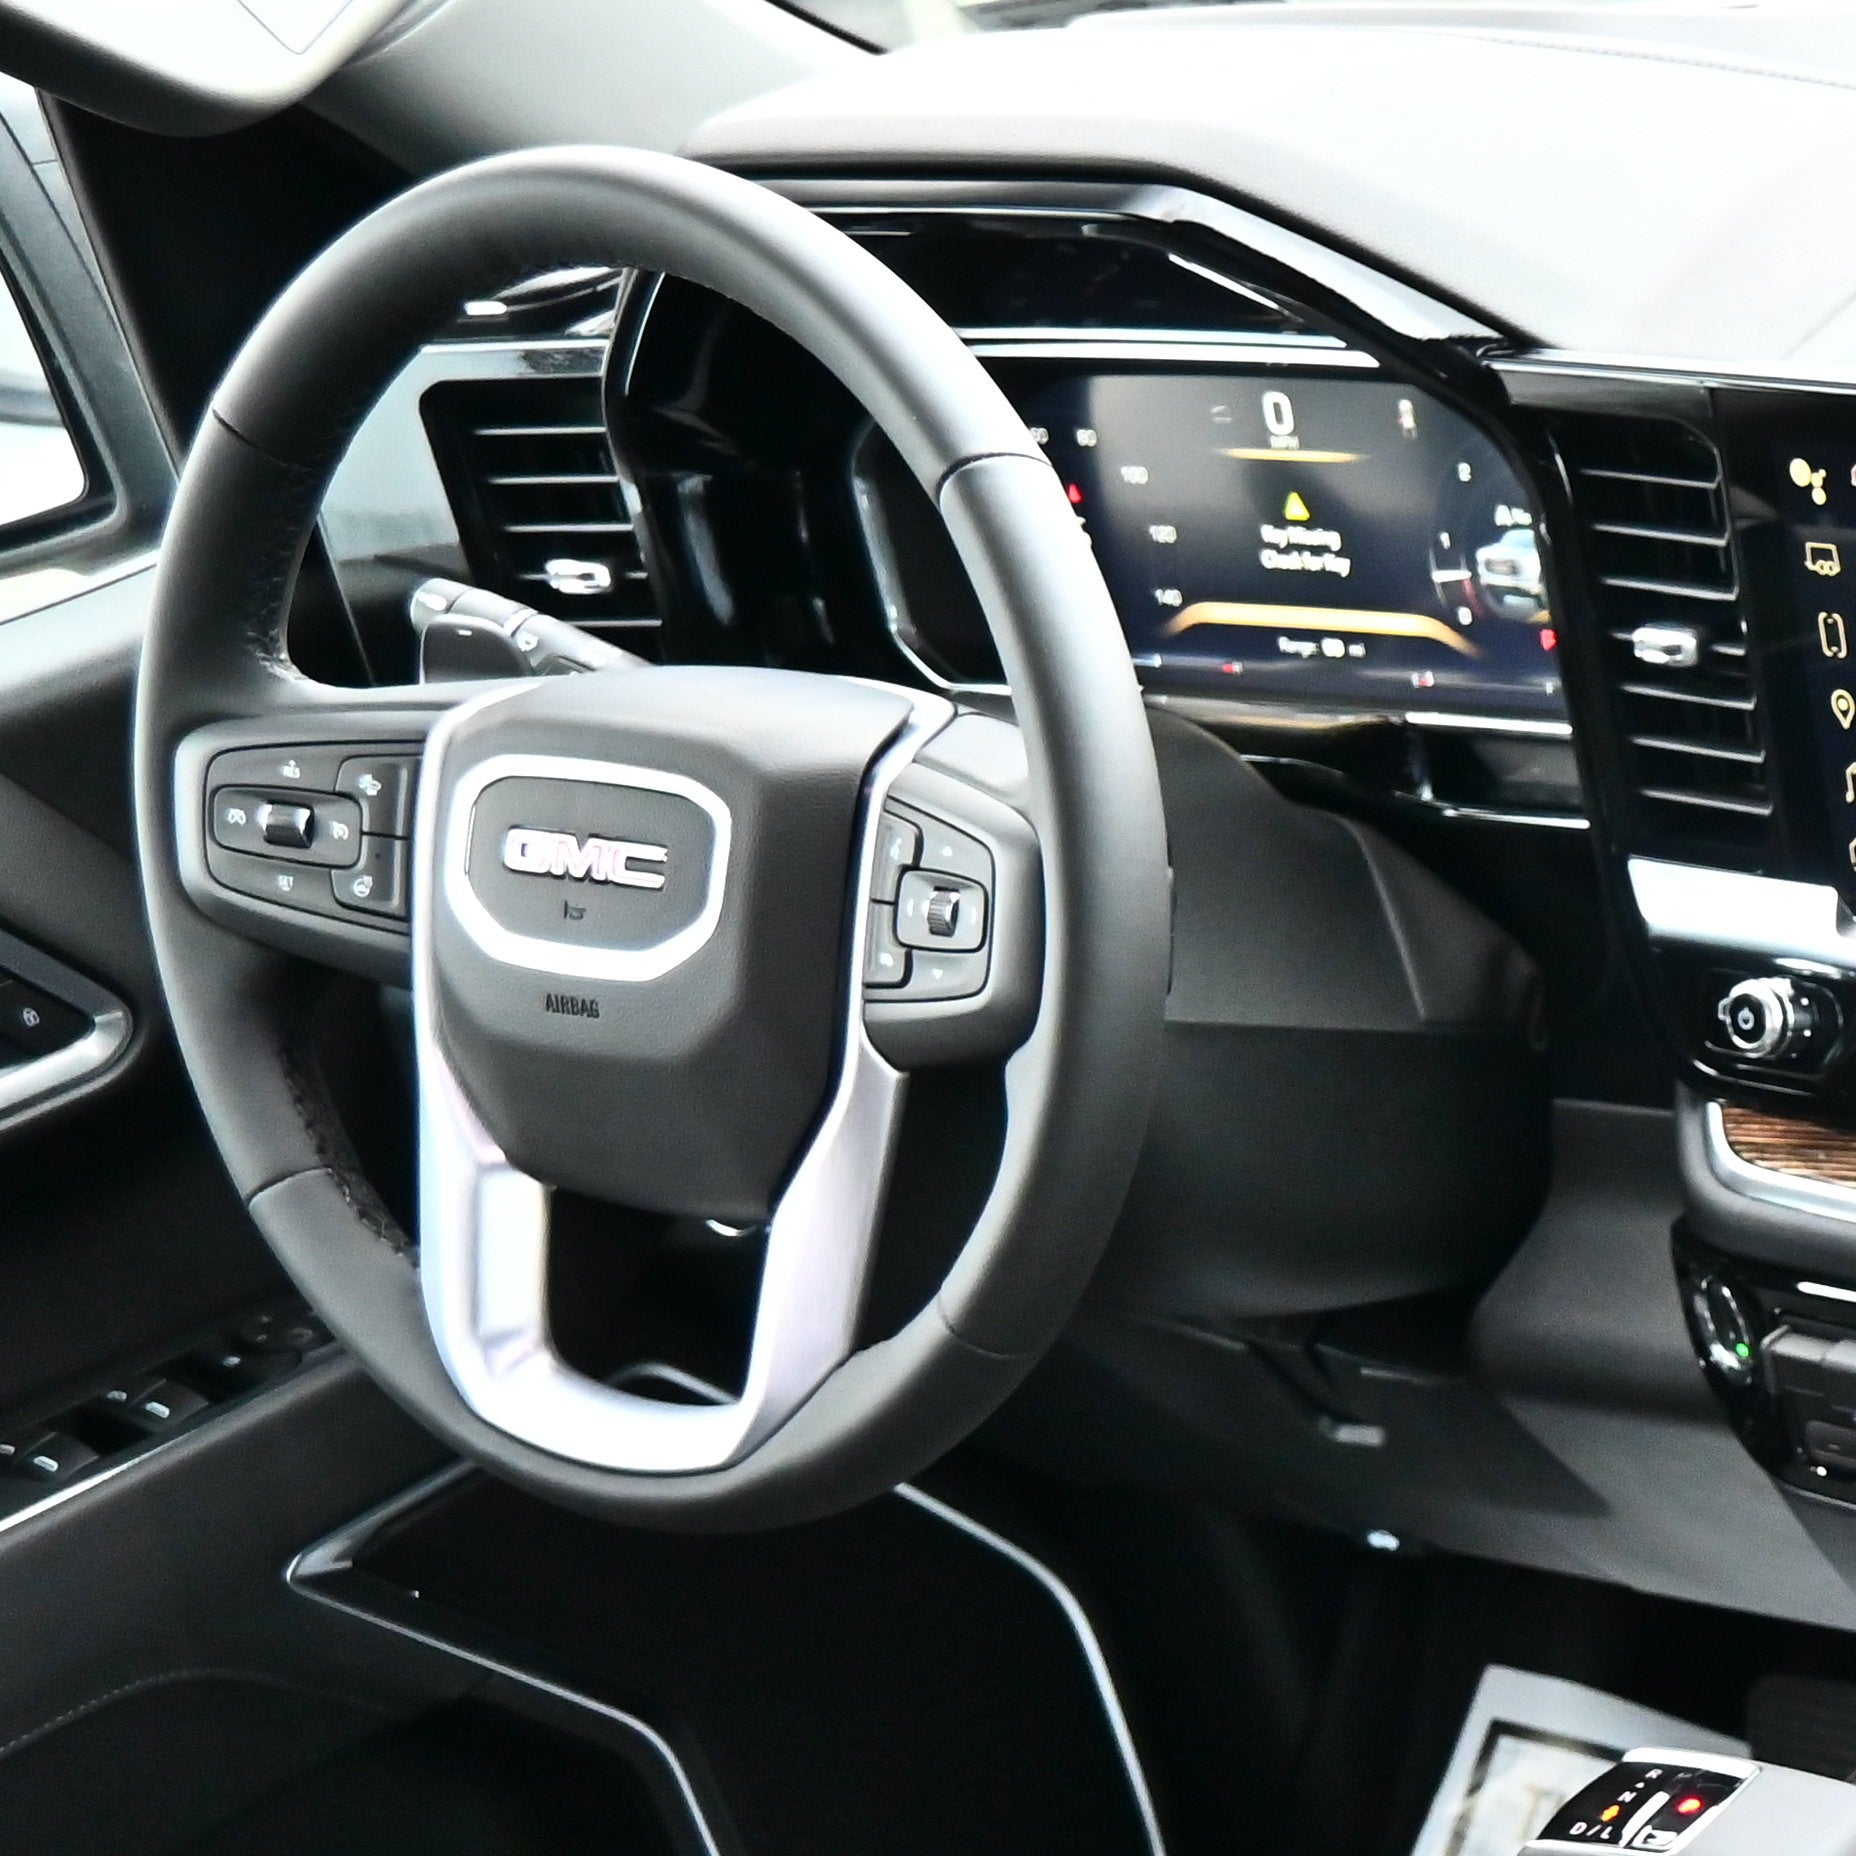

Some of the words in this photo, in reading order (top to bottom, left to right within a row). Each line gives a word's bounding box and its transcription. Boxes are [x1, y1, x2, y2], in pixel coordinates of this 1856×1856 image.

[1262, 391, 1294, 435] 0
[503, 825, 668, 891] GMC
[545, 993, 600, 1019] AIRBAG
[1645, 1768, 1663, 1779] R
[1617, 1791, 1638, 1803] N
